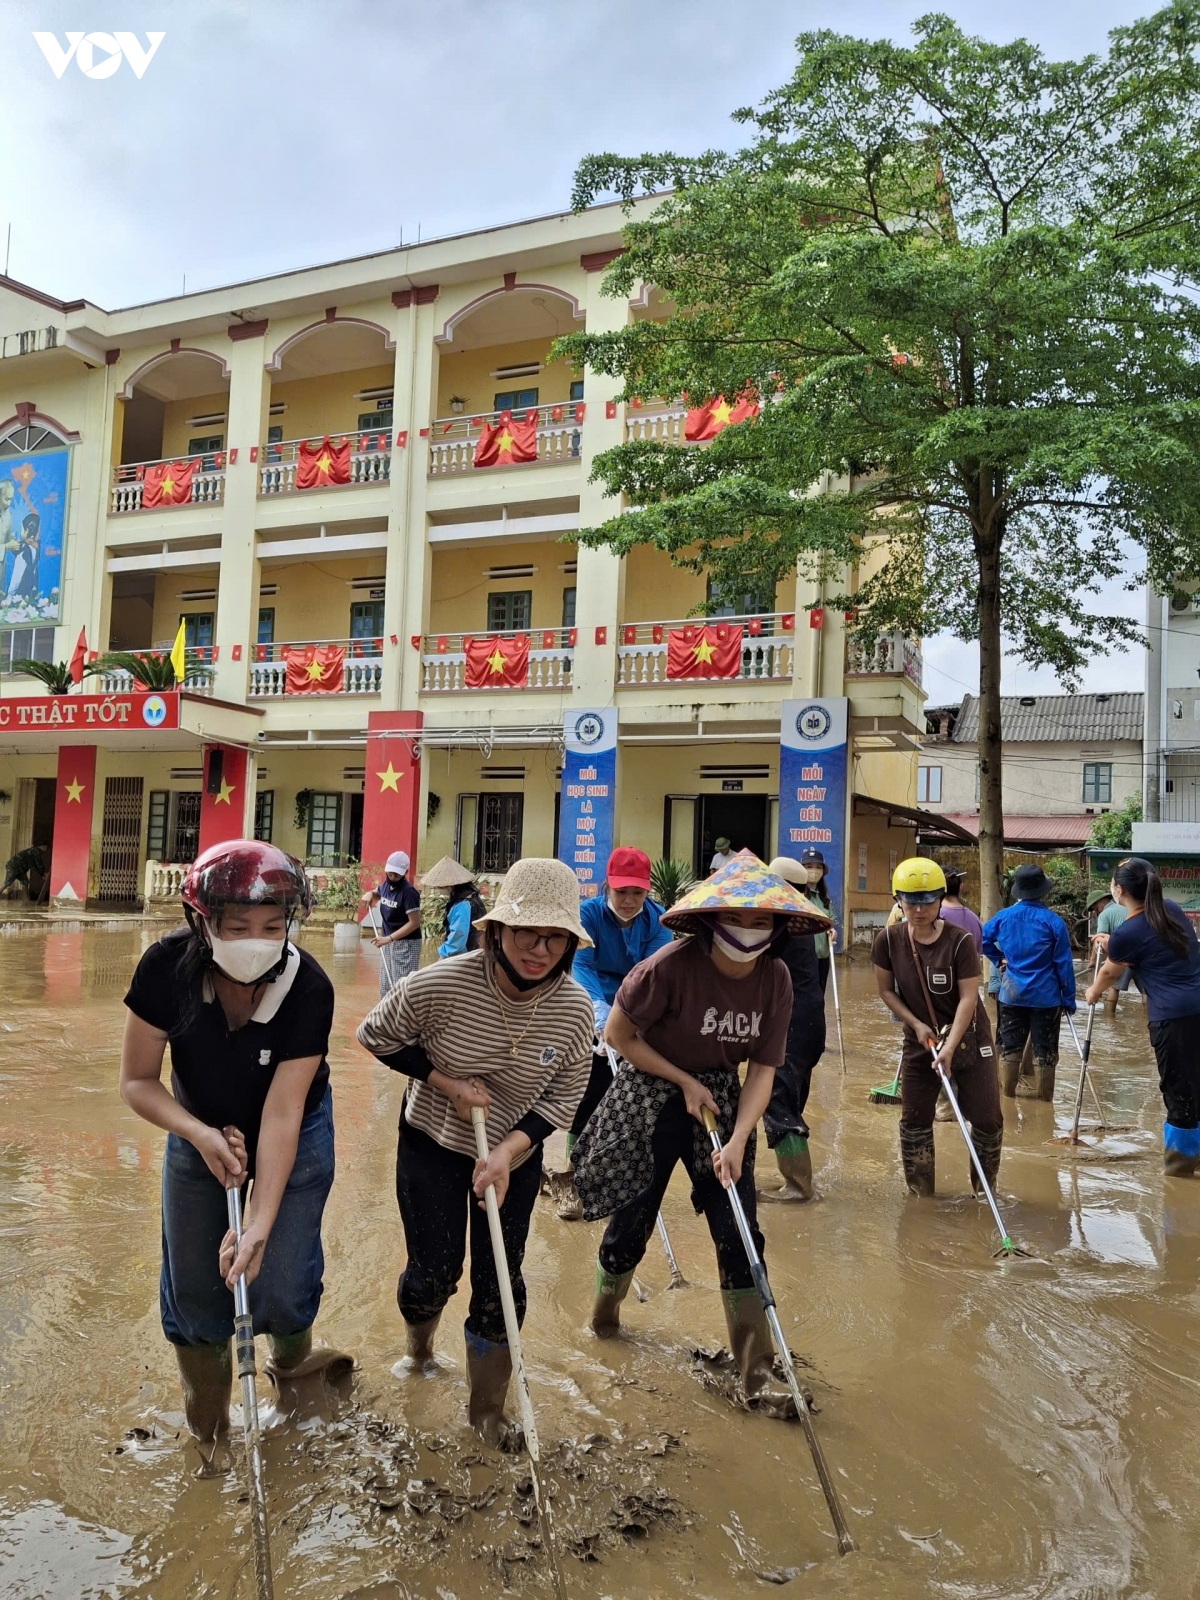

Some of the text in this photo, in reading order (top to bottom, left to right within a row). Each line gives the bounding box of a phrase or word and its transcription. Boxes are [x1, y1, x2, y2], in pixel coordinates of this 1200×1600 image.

[16, 700, 77, 729] THẬT
[83, 696, 131, 722] TỐT
[579, 765, 597, 780] MỖI
[802, 763, 823, 780] MỖI
[567, 785, 608, 798] HỌC SINH
[797, 785, 826, 801] NGÀY
[581, 800, 593, 813] LÀ
[800, 804, 822, 821] ĐẾN
[577, 816, 596, 831] MỘT
[576, 833, 595, 846] NHÀ
[790, 826, 831, 842] TRƯỜNG
[574, 848, 595, 863] KIẾN
[575, 868, 593, 881] TẠO
[700, 1007, 762, 1038] BACK
